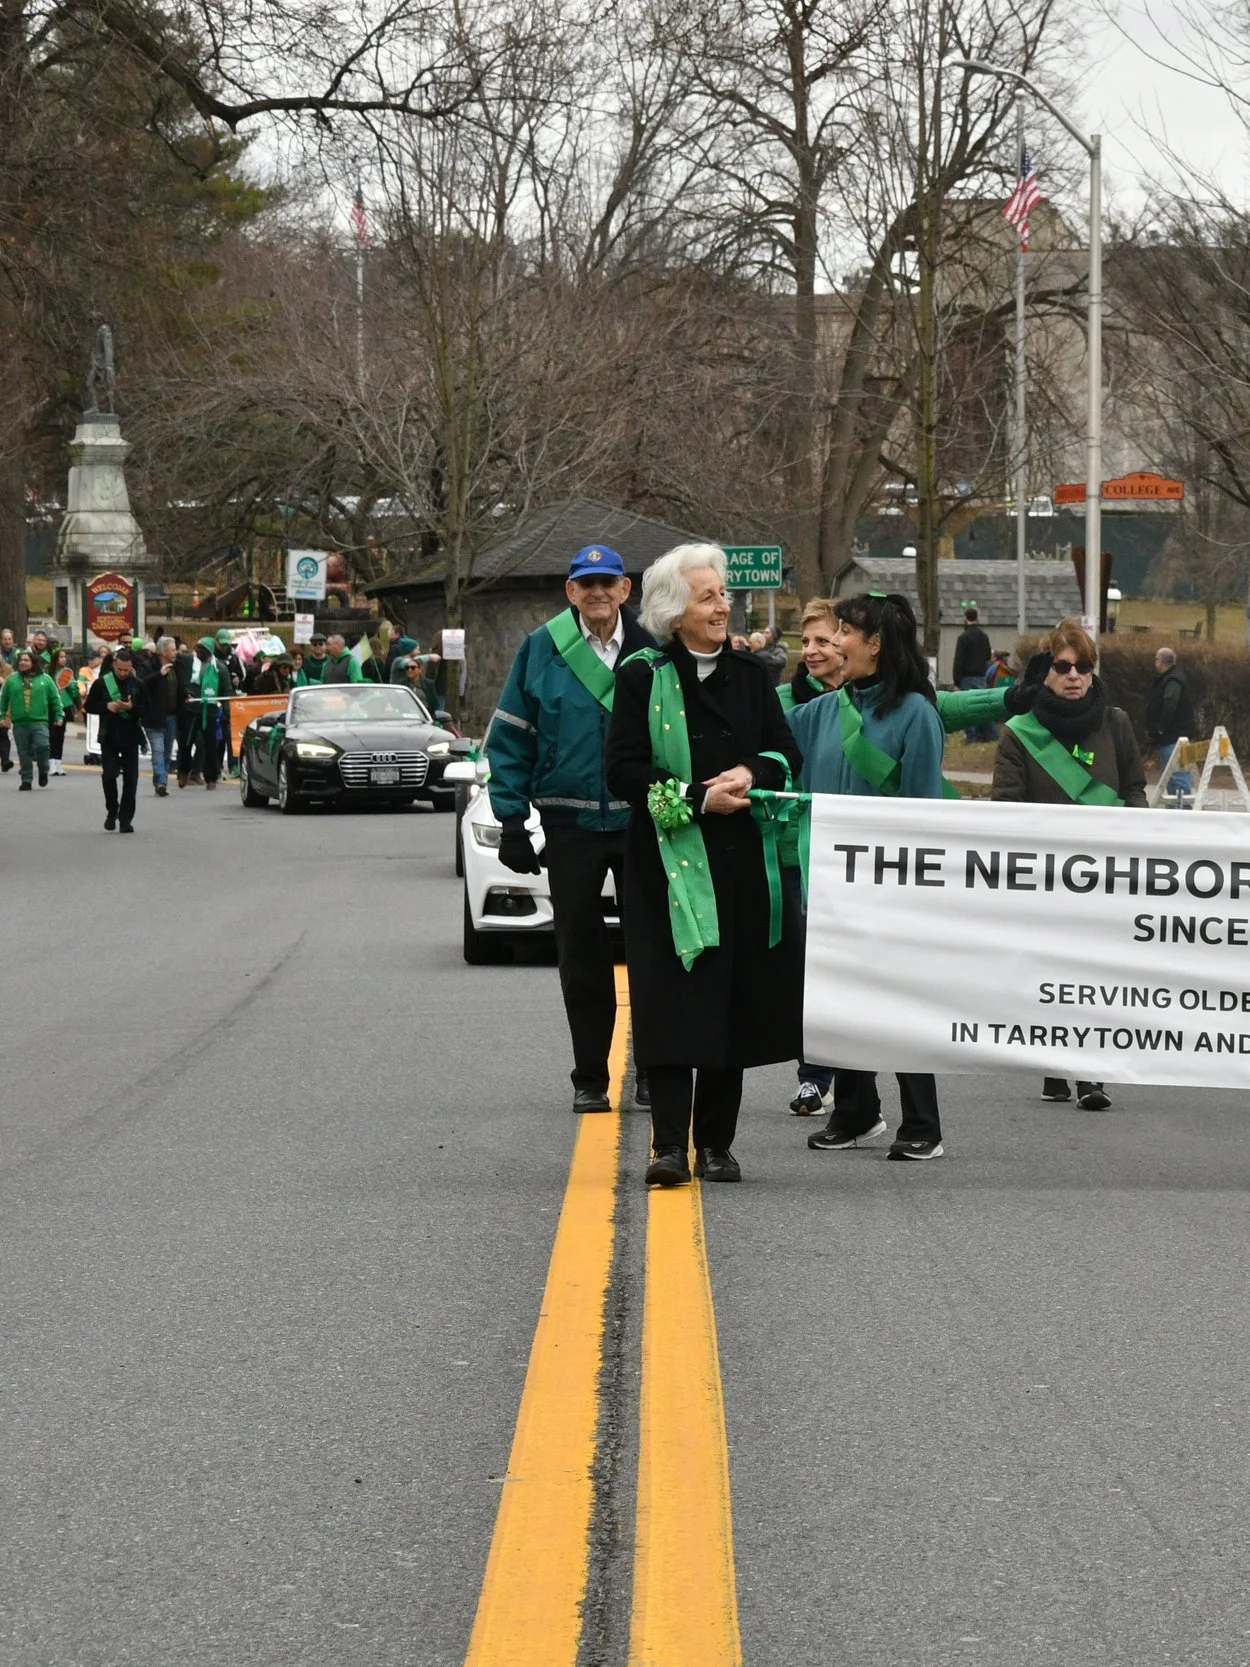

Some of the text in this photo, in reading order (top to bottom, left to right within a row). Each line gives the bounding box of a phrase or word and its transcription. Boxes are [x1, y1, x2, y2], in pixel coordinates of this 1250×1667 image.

[1105, 485, 1160, 495] COLLEGE
[762, 552, 778, 565] OF
[726, 570, 779, 583] RYTOWN
[91, 583, 130, 597] WELCOME
[834, 844, 946, 887] THE
[1133, 914, 1248, 945] SINCE
[1039, 982, 1172, 1009] SERVING
[951, 1022, 979, 1043] IN
[988, 1023, 1183, 1051] TARRYTOWN
